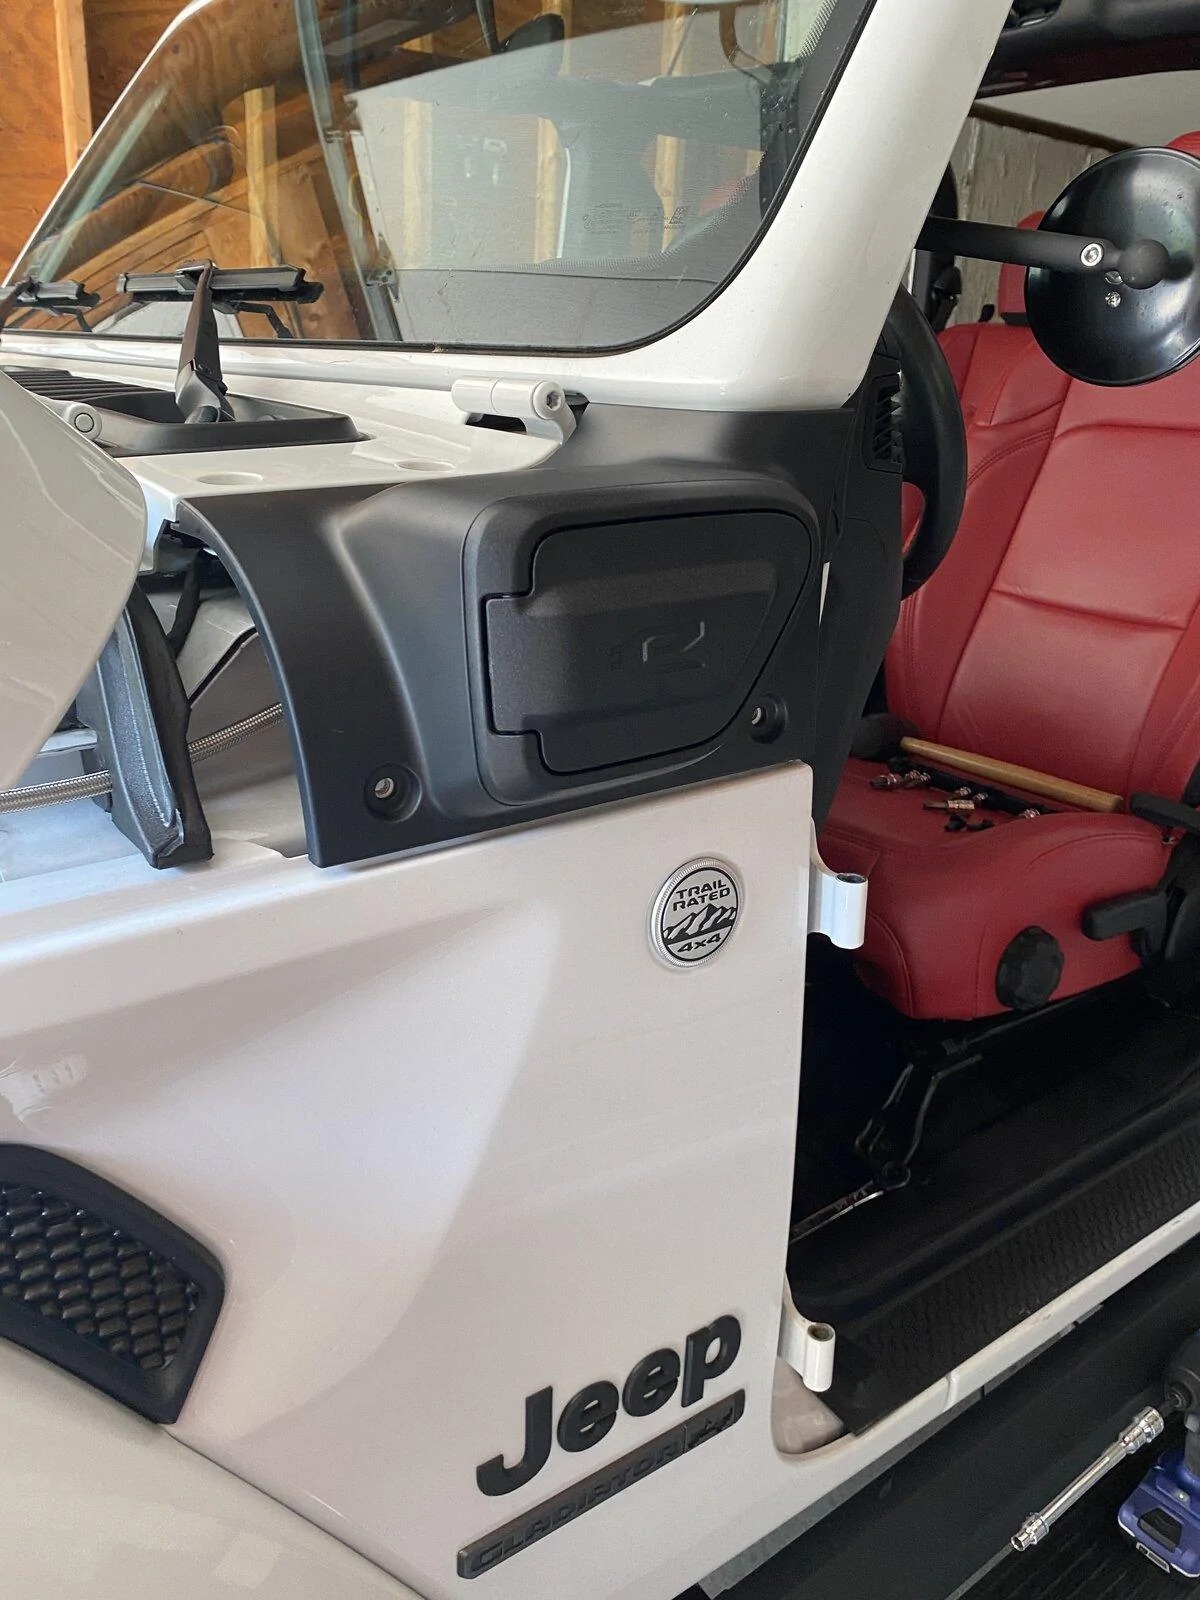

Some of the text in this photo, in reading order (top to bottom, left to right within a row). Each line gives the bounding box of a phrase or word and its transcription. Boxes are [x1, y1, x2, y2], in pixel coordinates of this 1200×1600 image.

[672, 887, 731, 911] RATED
[676, 879, 727, 900] TRAIL
[677, 933, 722, 953] 4x4
[476, 1314, 742, 1497] Jeep
[470, 1443, 681, 1571] GLADIATOR
